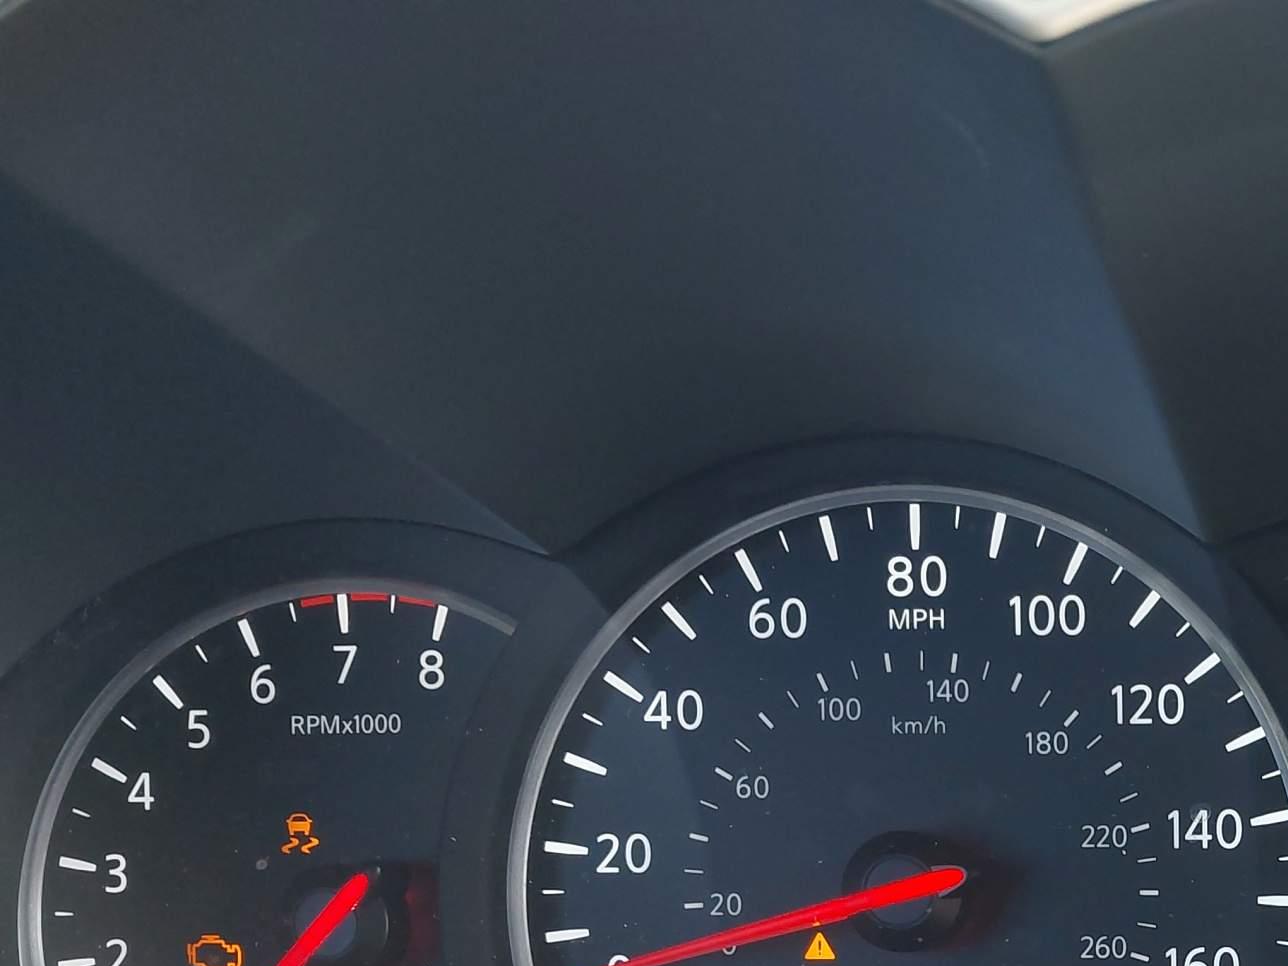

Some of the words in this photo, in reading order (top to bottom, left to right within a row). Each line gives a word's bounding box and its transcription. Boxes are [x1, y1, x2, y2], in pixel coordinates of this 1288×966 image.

[886, 555, 947, 598] 80
[749, 597, 807, 639] 60
[888, 608, 945, 630] MPH
[1009, 594, 1086, 636] 100
[333, 645, 358, 684] 7
[419, 649, 445, 690] 8
[250, 664, 276, 705] 6
[926, 678, 969, 703] 140
[1111, 683, 1185, 725] 120
[291, 713, 402, 735] RPMx1000
[643, 689, 703, 731] 40
[817, 697, 861, 721] 100
[891, 715, 946, 734] km/h
[187, 709, 211, 749] 5
[1025, 731, 1069, 755] 180
[127, 772, 155, 811] 4
[736, 775, 769, 799] 60
[1081, 824, 1128, 848] 220
[1167, 808, 1243, 850] 140
[596, 833, 652, 874] 20
[104, 853, 128, 894] 3
[710, 892, 742, 916] 20
[1080, 935, 1127, 959] 260
